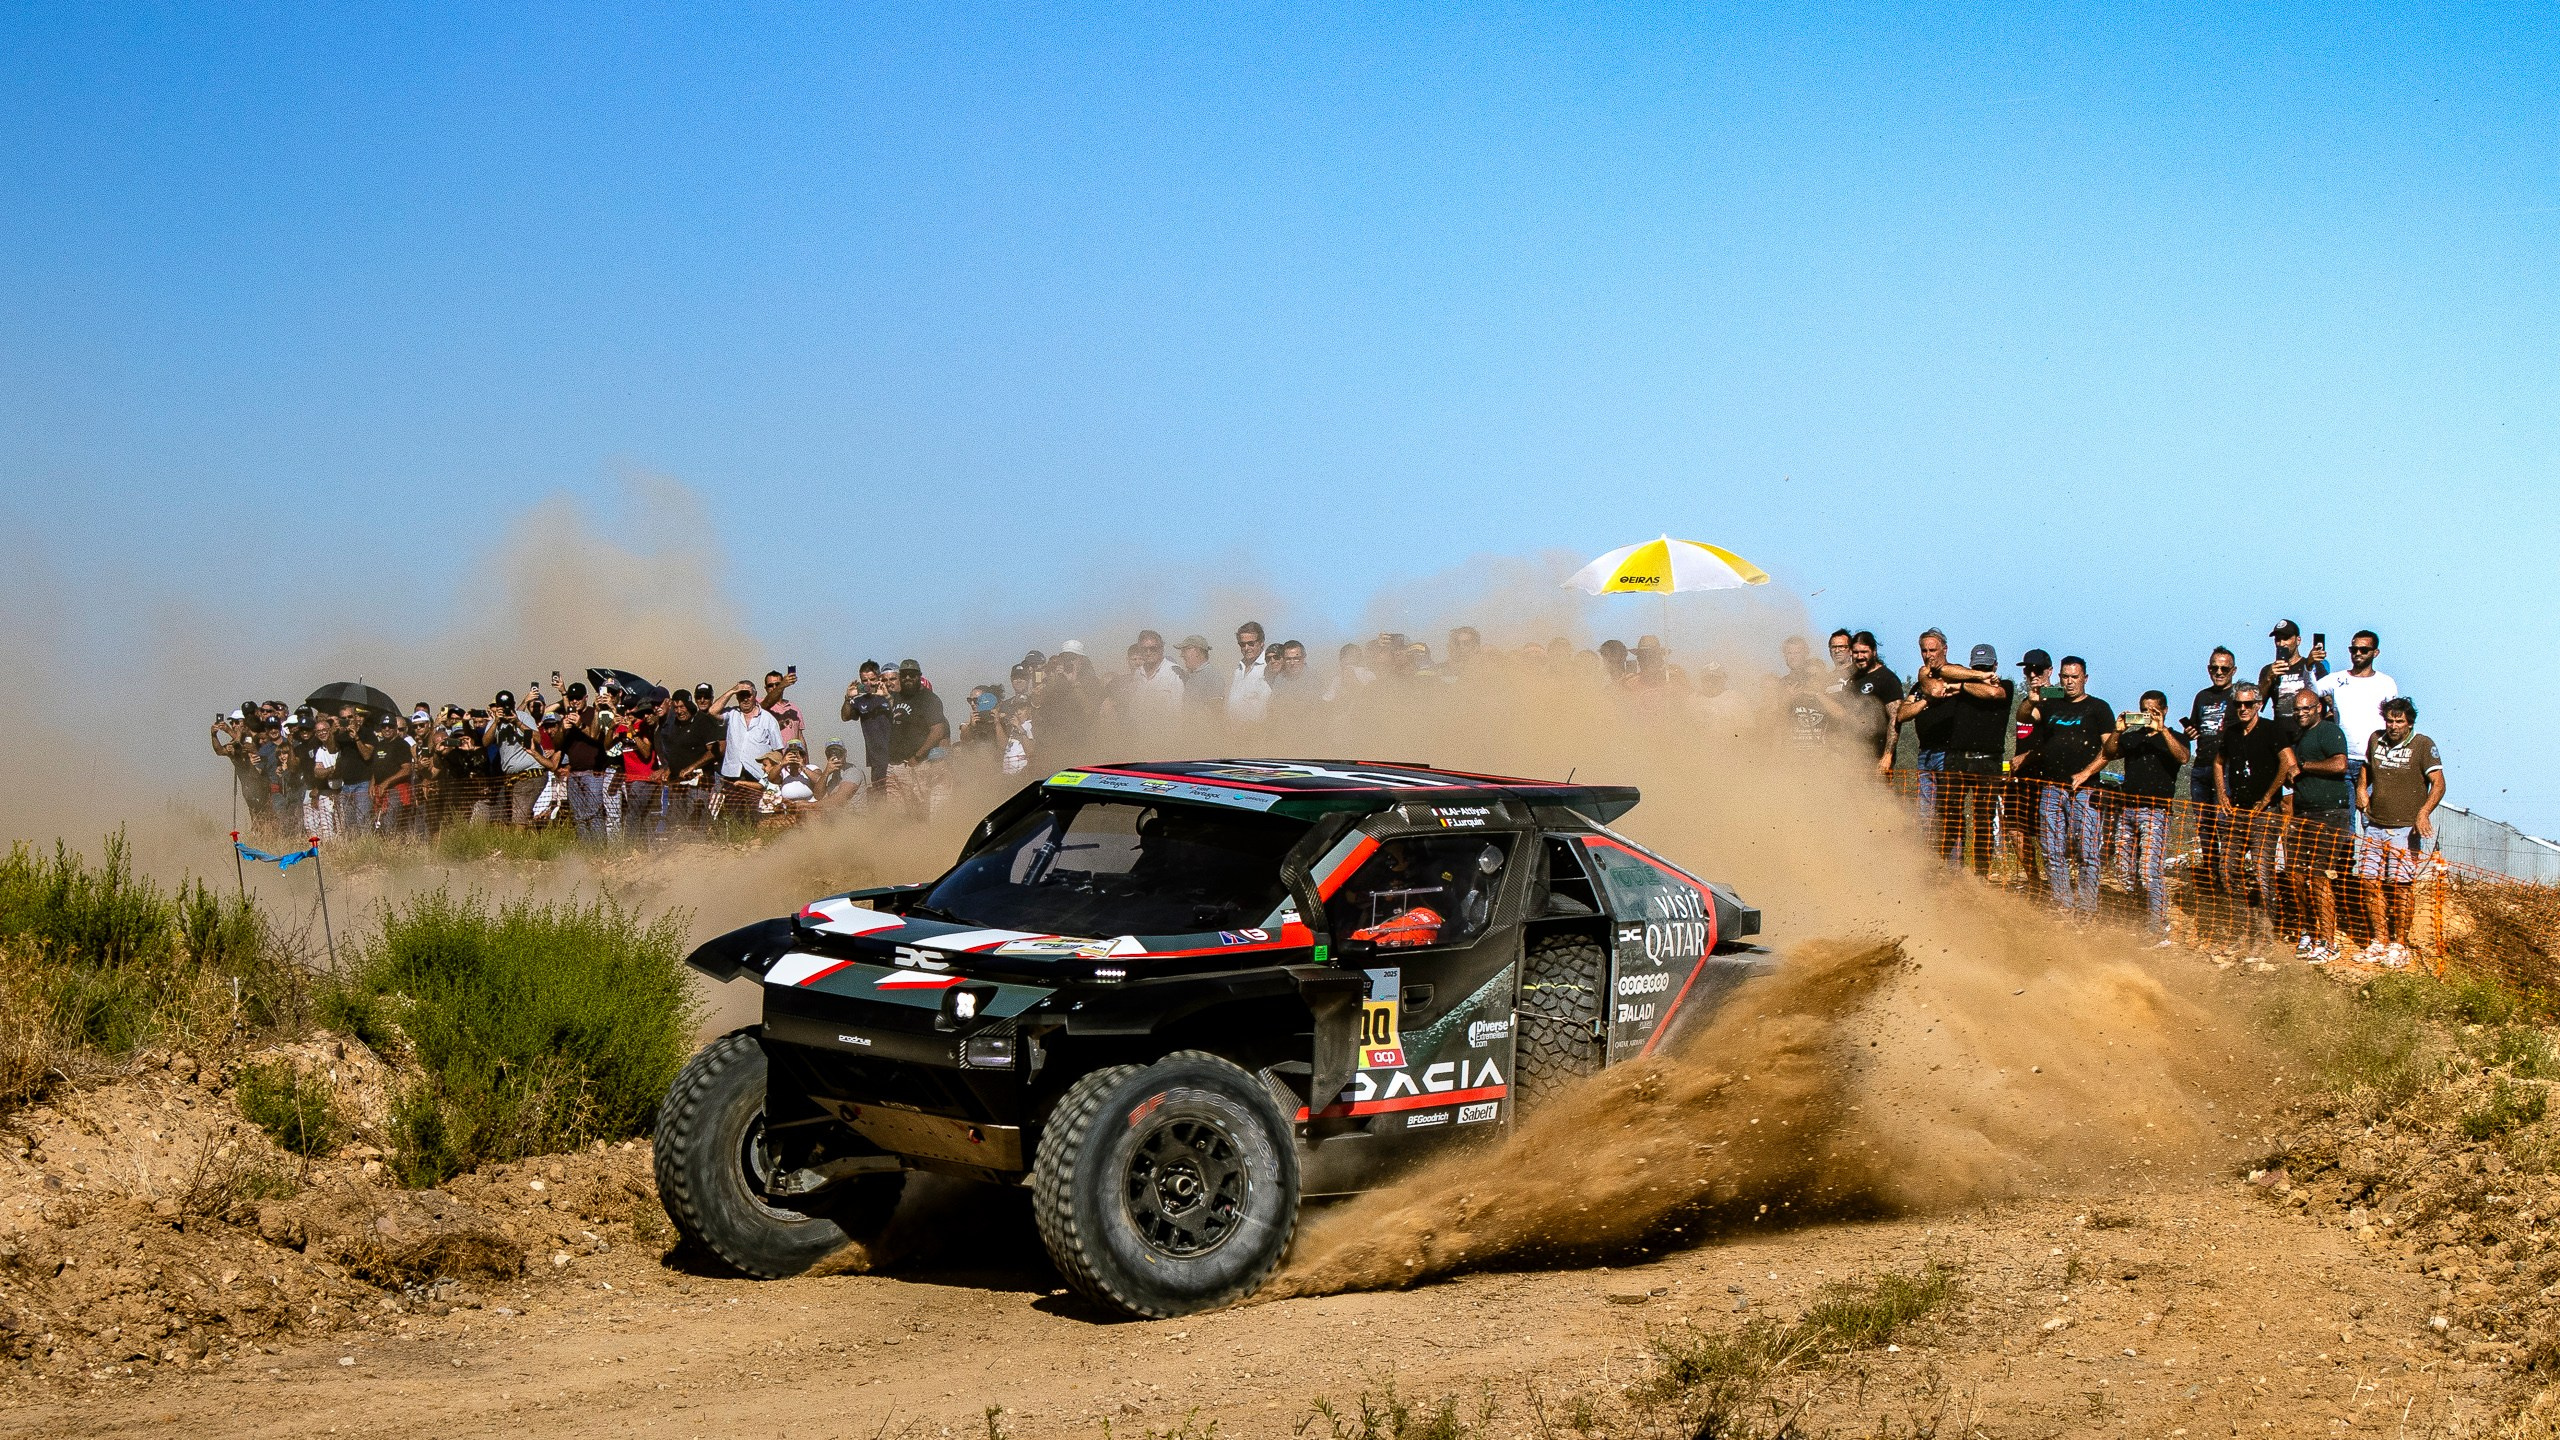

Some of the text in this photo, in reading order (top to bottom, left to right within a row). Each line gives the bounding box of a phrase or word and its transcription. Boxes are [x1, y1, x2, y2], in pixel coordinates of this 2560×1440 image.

[1620, 576, 1660, 584] OEIRAS
[1654, 885, 1703, 919] visit
[1645, 922, 1705, 966] QATAR
[1618, 972, 1669, 995] ooredoo
[1618, 1003, 1655, 1023] BALADI
[1476, 1020, 1509, 1033] Diverse
[1374, 1051, 1396, 1064] acp
[1340, 1056, 1505, 1103] DACIA
[1407, 1111, 1449, 1125] BFGoodrich
[1461, 1104, 1494, 1122] Sabelt
